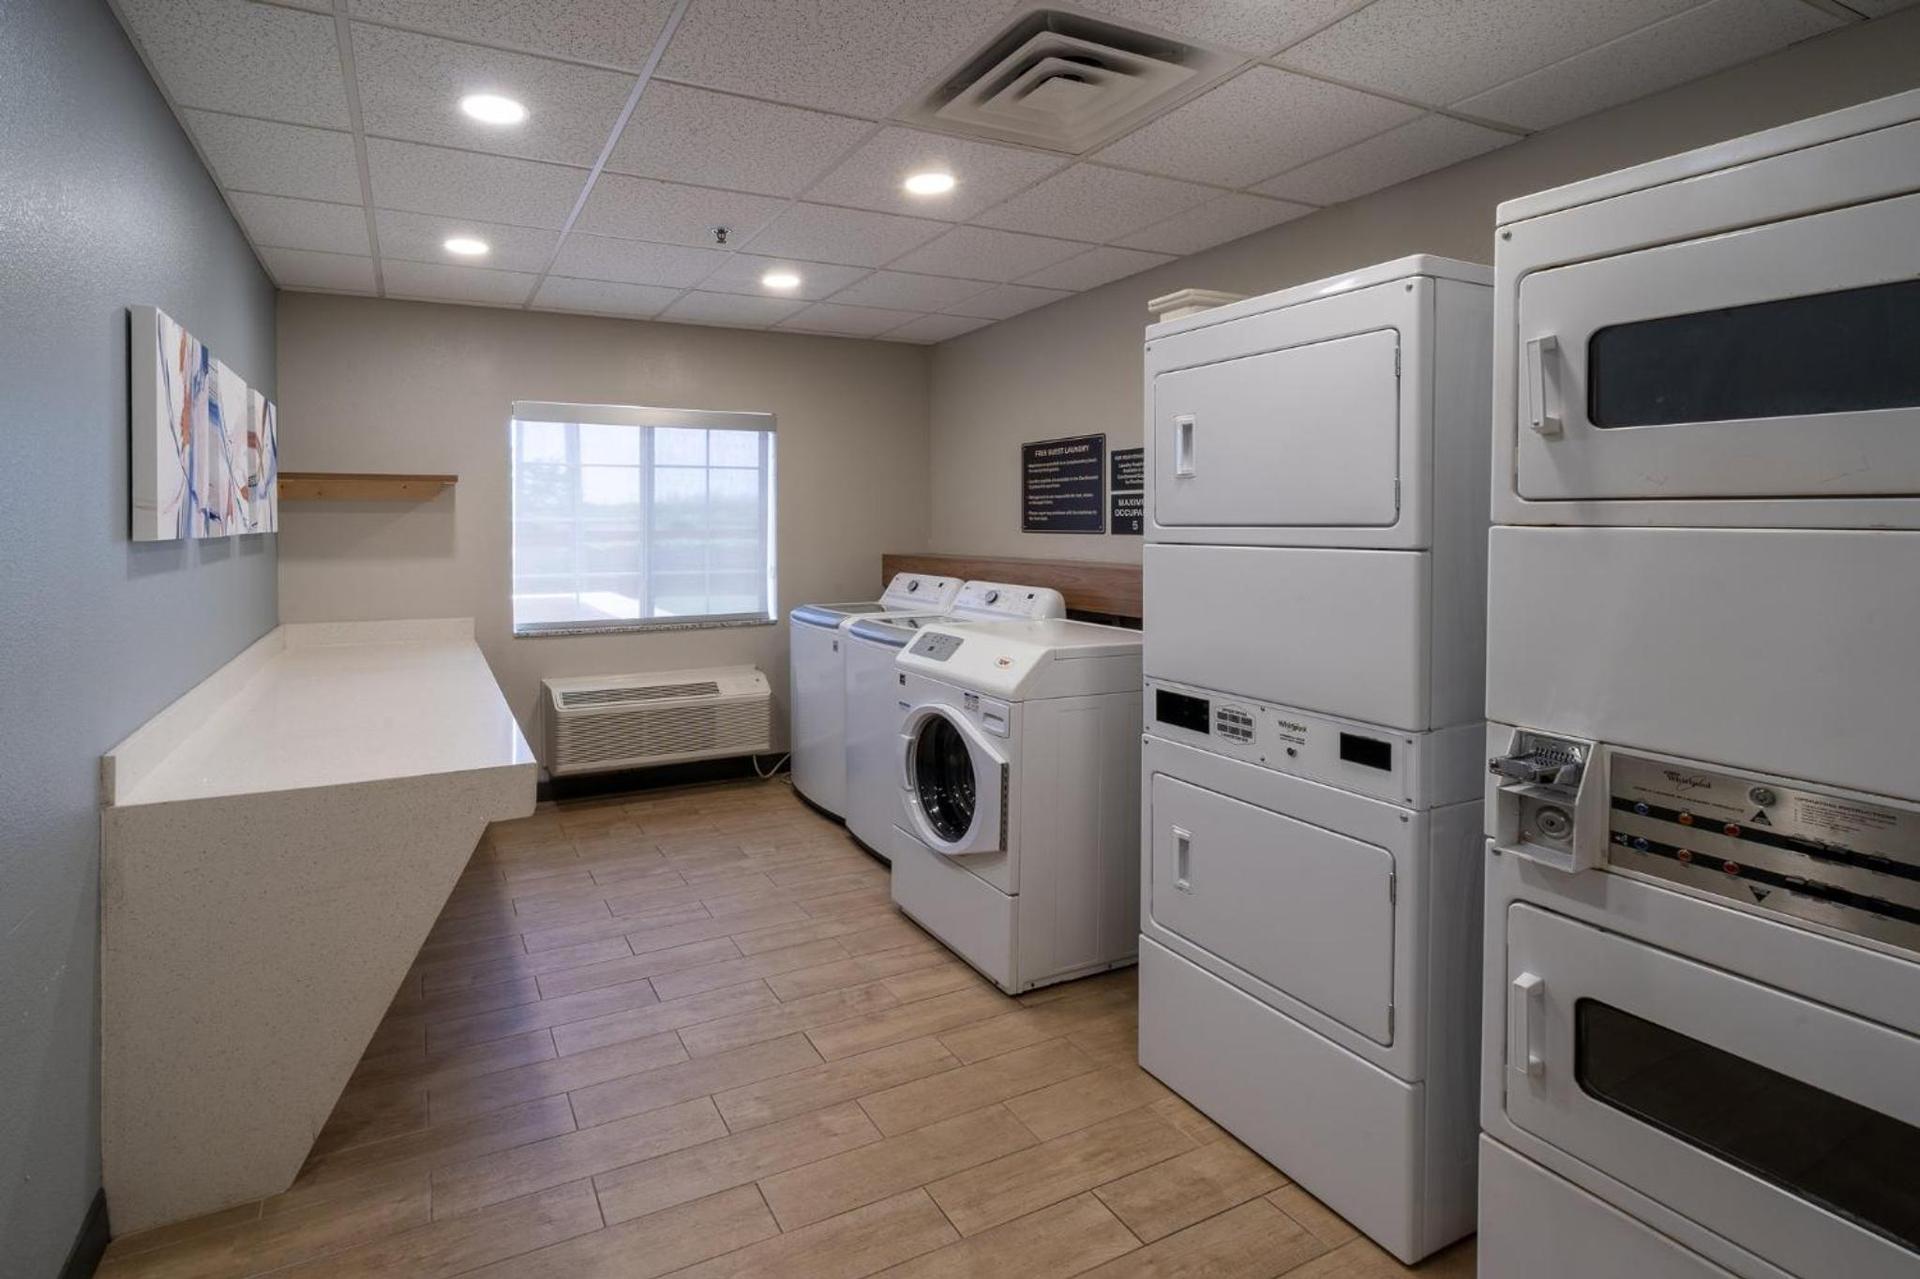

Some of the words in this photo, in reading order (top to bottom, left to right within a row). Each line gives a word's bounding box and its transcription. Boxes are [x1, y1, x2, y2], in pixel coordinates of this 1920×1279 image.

[1035, 449, 1047, 457] FREE
[1065, 444, 1089, 454] LAUNDRY
[1114, 508, 1144, 517] OCCUPA
[1132, 520, 1139, 531] 5
[1277, 719, 1307, 733] Whirlpool
[1666, 773, 1711, 790] Whirlpool
